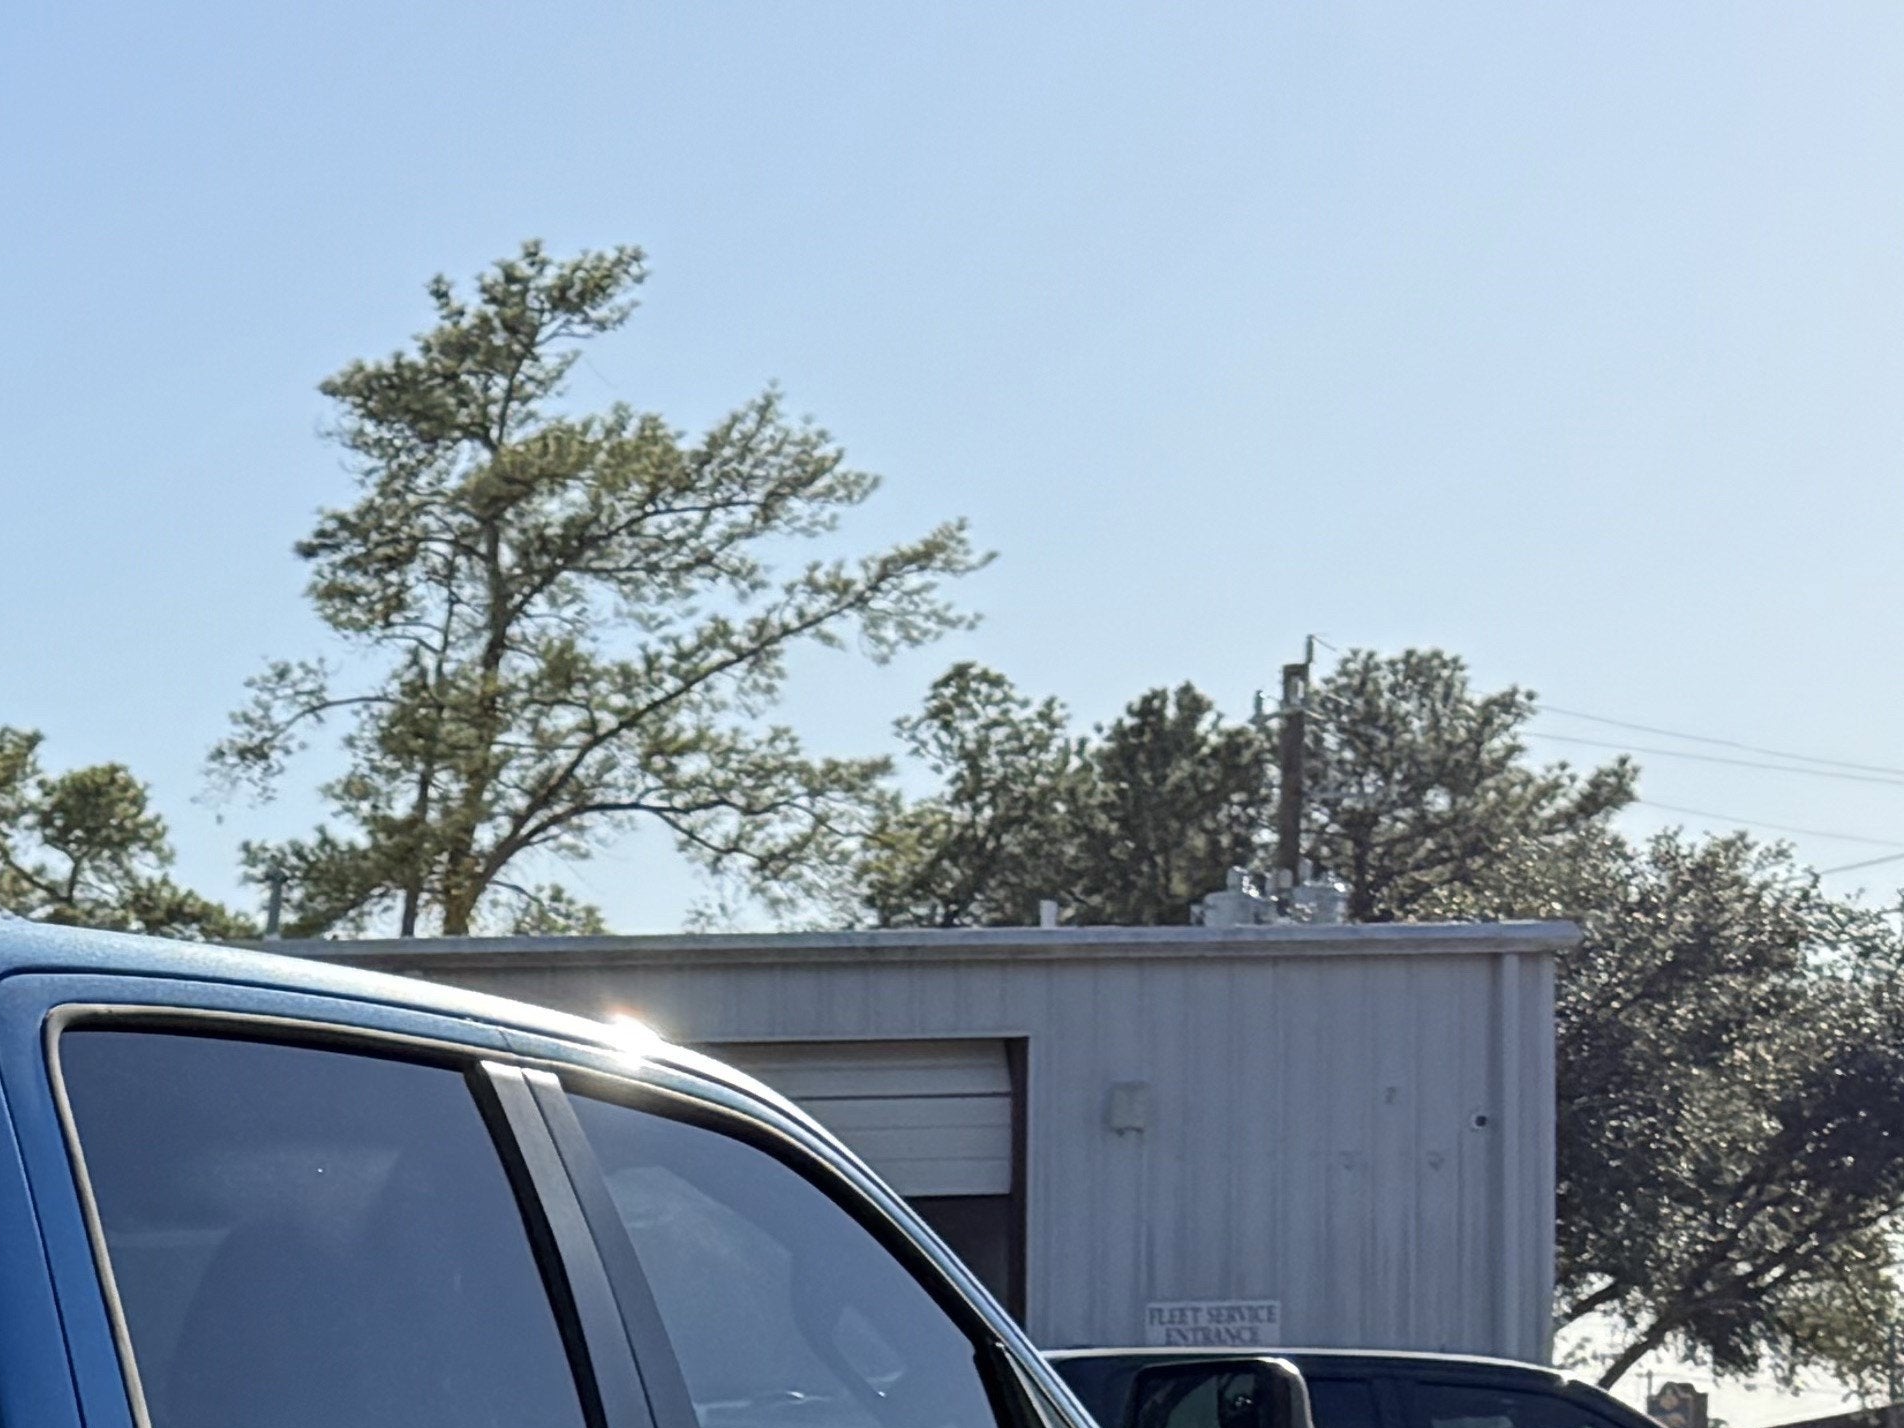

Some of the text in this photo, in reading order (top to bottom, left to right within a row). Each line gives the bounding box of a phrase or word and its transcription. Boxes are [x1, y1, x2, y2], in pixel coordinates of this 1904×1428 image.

[1149, 1304, 1277, 1325] FLEET SERVICE
[1165, 1326, 1260, 1345] ENTRANCE
